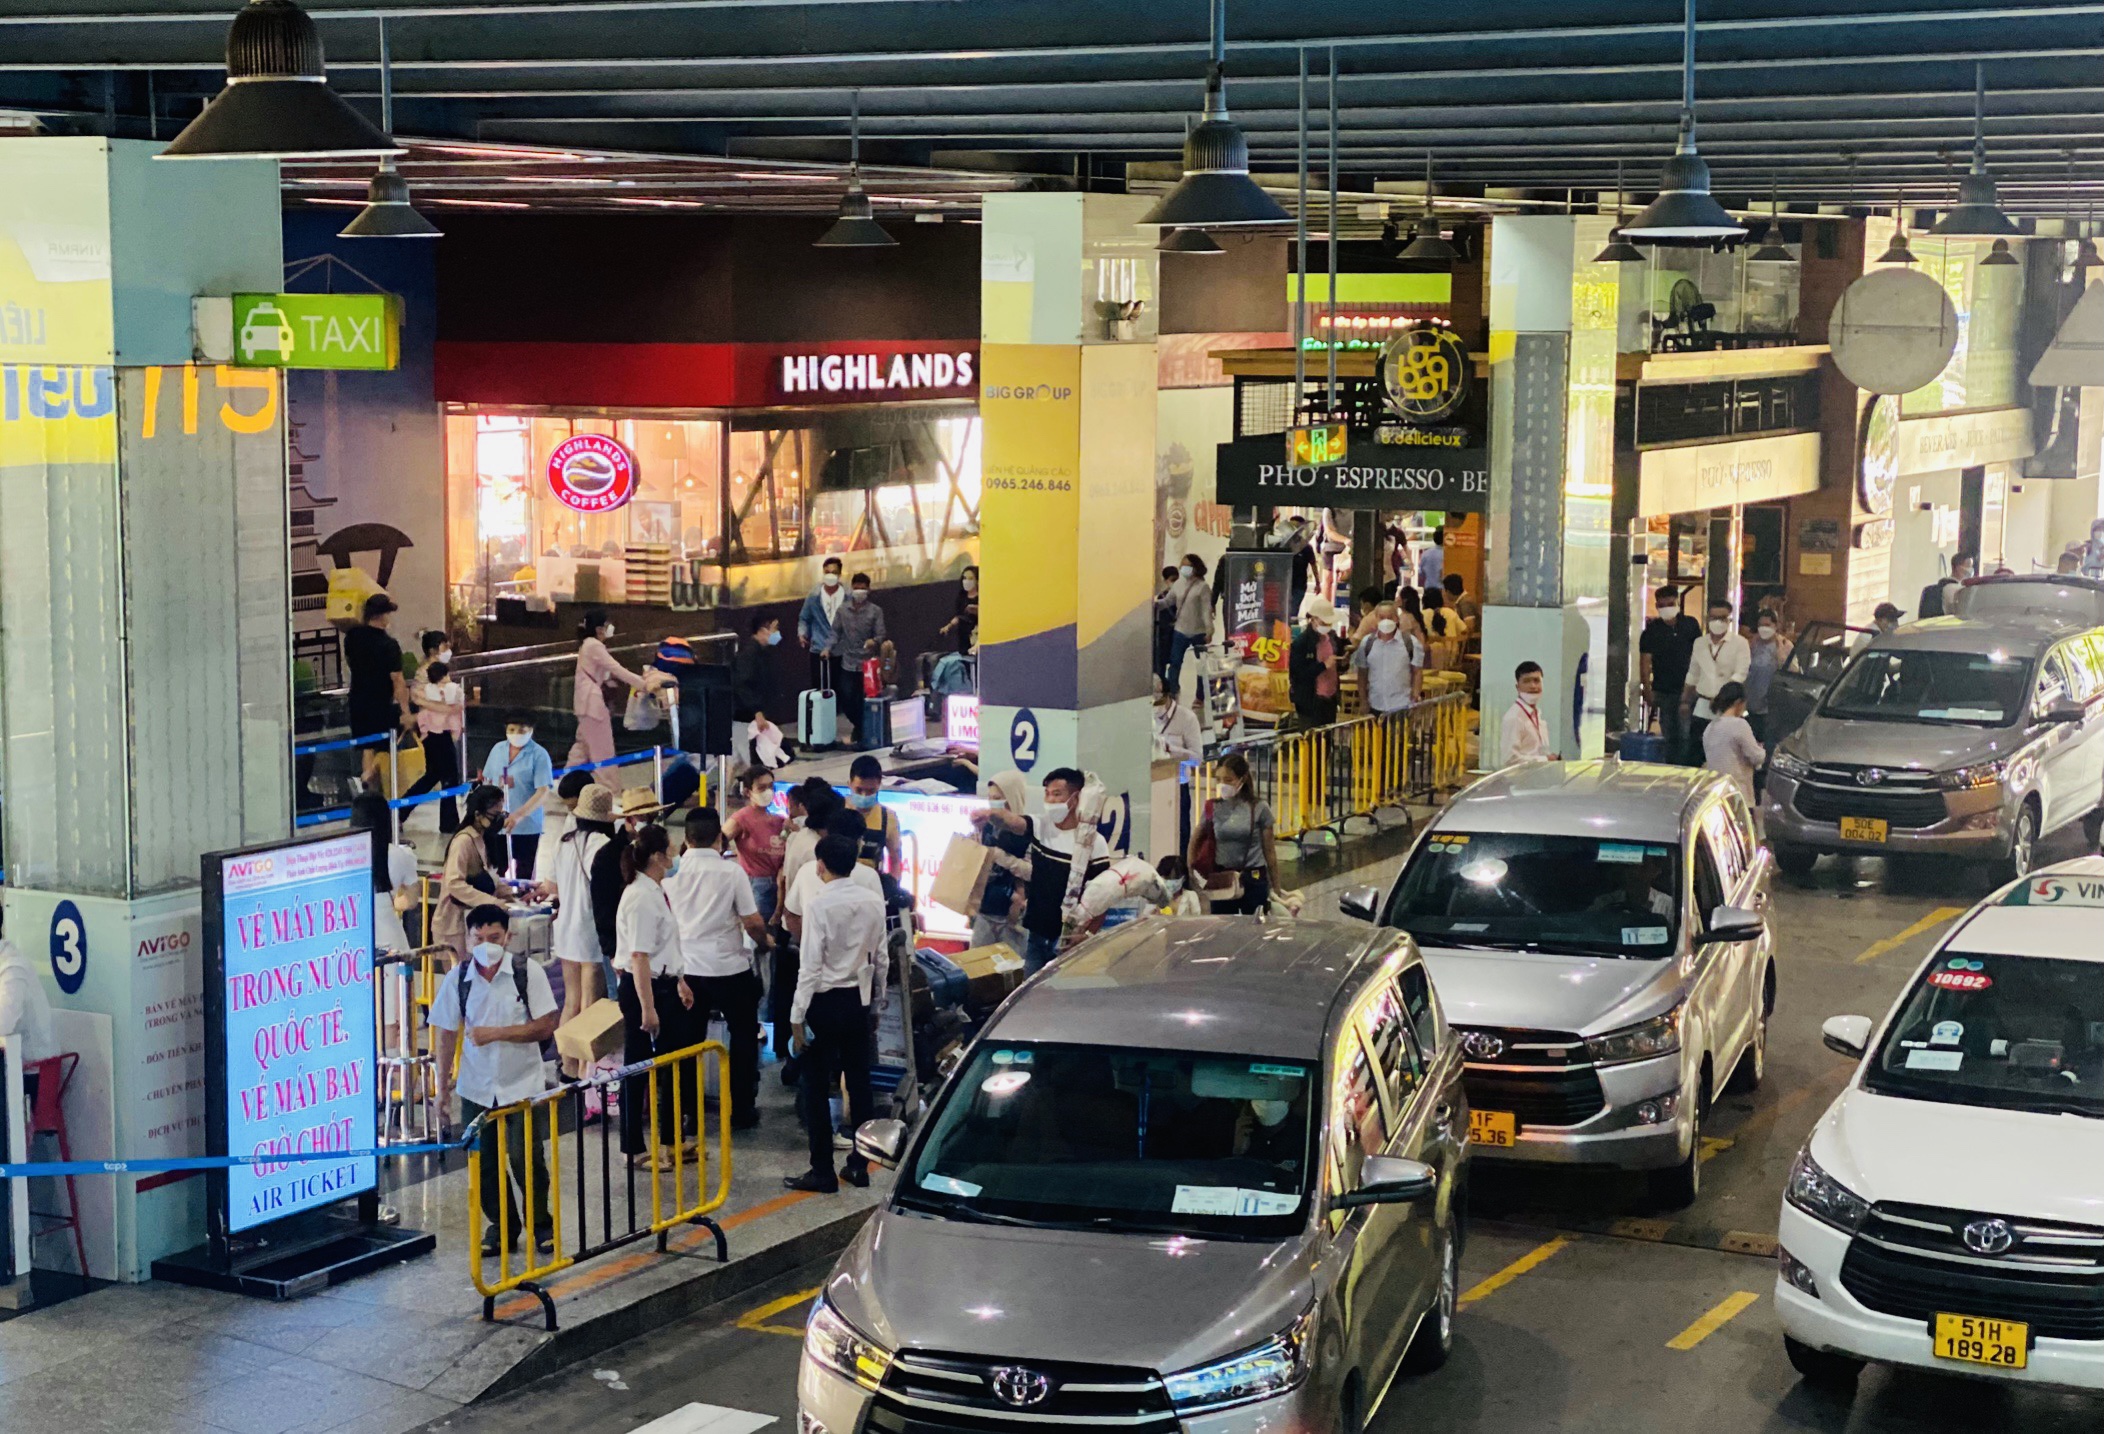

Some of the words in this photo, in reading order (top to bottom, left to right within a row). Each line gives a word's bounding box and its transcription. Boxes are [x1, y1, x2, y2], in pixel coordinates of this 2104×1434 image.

[301, 315, 380, 353] TAXI
[783, 352, 973, 392] HIGHLANDS
[985, 385, 1011, 399] BIG
[1013, 383, 1072, 401] GROUP
[552, 439, 627, 470] HIGHLANDS
[561, 489, 618, 508] COFFEE
[986, 477, 1072, 491] 0965.246.846
[1335, 467, 1444, 491] ESPRESSO
[1015, 721, 1035, 760] 2
[1102, 796, 1125, 858] 2
[237, 902, 266, 950] VÉ
[271, 895, 319, 945] MÁY
[322, 893, 361, 935] BAY
[56, 918, 82, 975] 3
[228, 962, 303, 1012] TRONG
[306, 941, 373, 993] NƯỚC,
[1934, 972, 1986, 988] 10692
[254, 1009, 314, 1070] QUỐC
[241, 1075, 268, 1124] VÉ
[274, 1063, 320, 1115] MÁY
[325, 1059, 364, 1102] BAY
[253, 1124, 292, 1179] GIỜ
[296, 1110, 354, 1164] CHÓT
[249, 1185, 283, 1216] AIR
[288, 1162, 359, 1204] TICKET
[1961, 1318, 2002, 1342] 51H
[1946, 1338, 2016, 1364] 189.28
